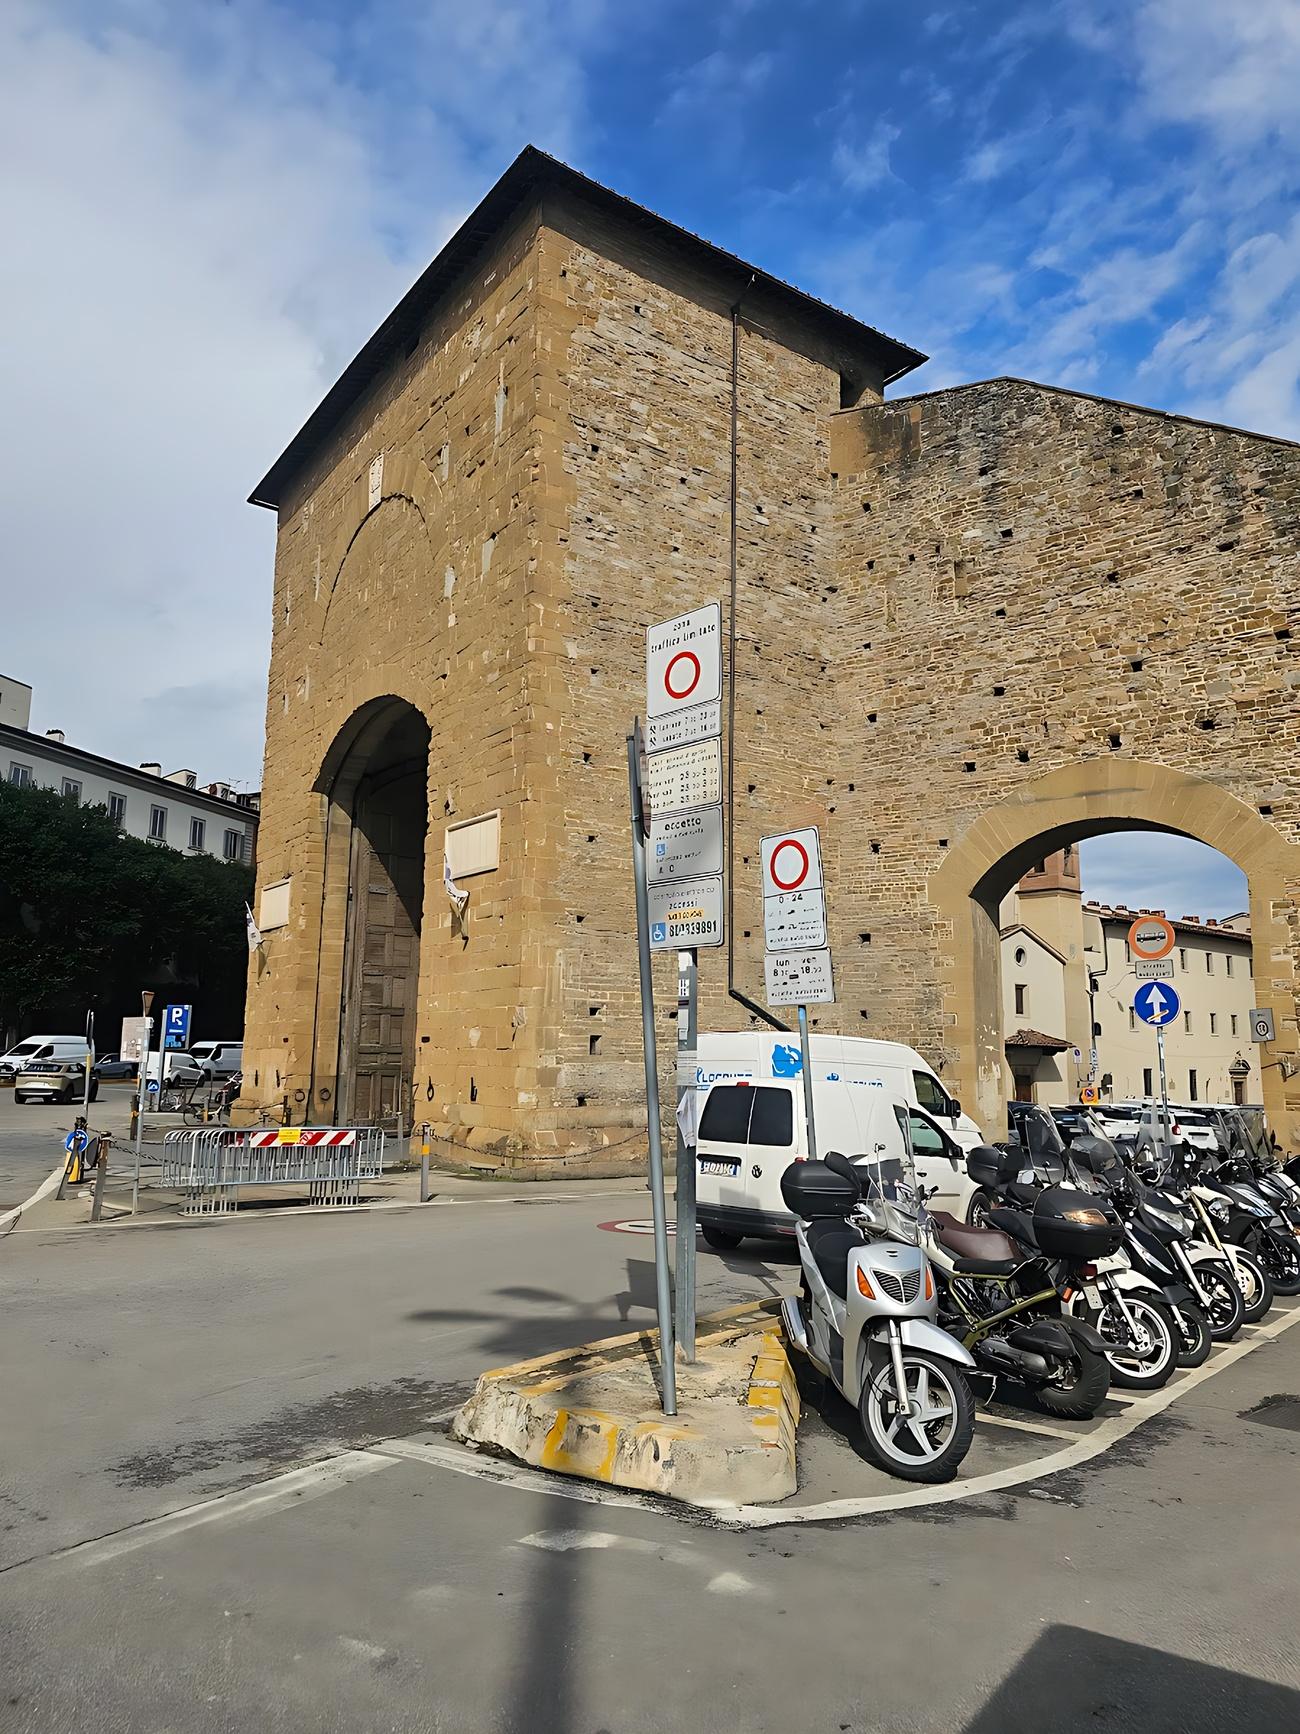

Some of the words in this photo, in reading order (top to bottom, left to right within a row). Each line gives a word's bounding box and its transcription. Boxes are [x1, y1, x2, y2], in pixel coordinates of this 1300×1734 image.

[683, 624, 716, 641] limtato
[664, 817, 701, 831] eccetto
[776, 959, 790, 967] lun
